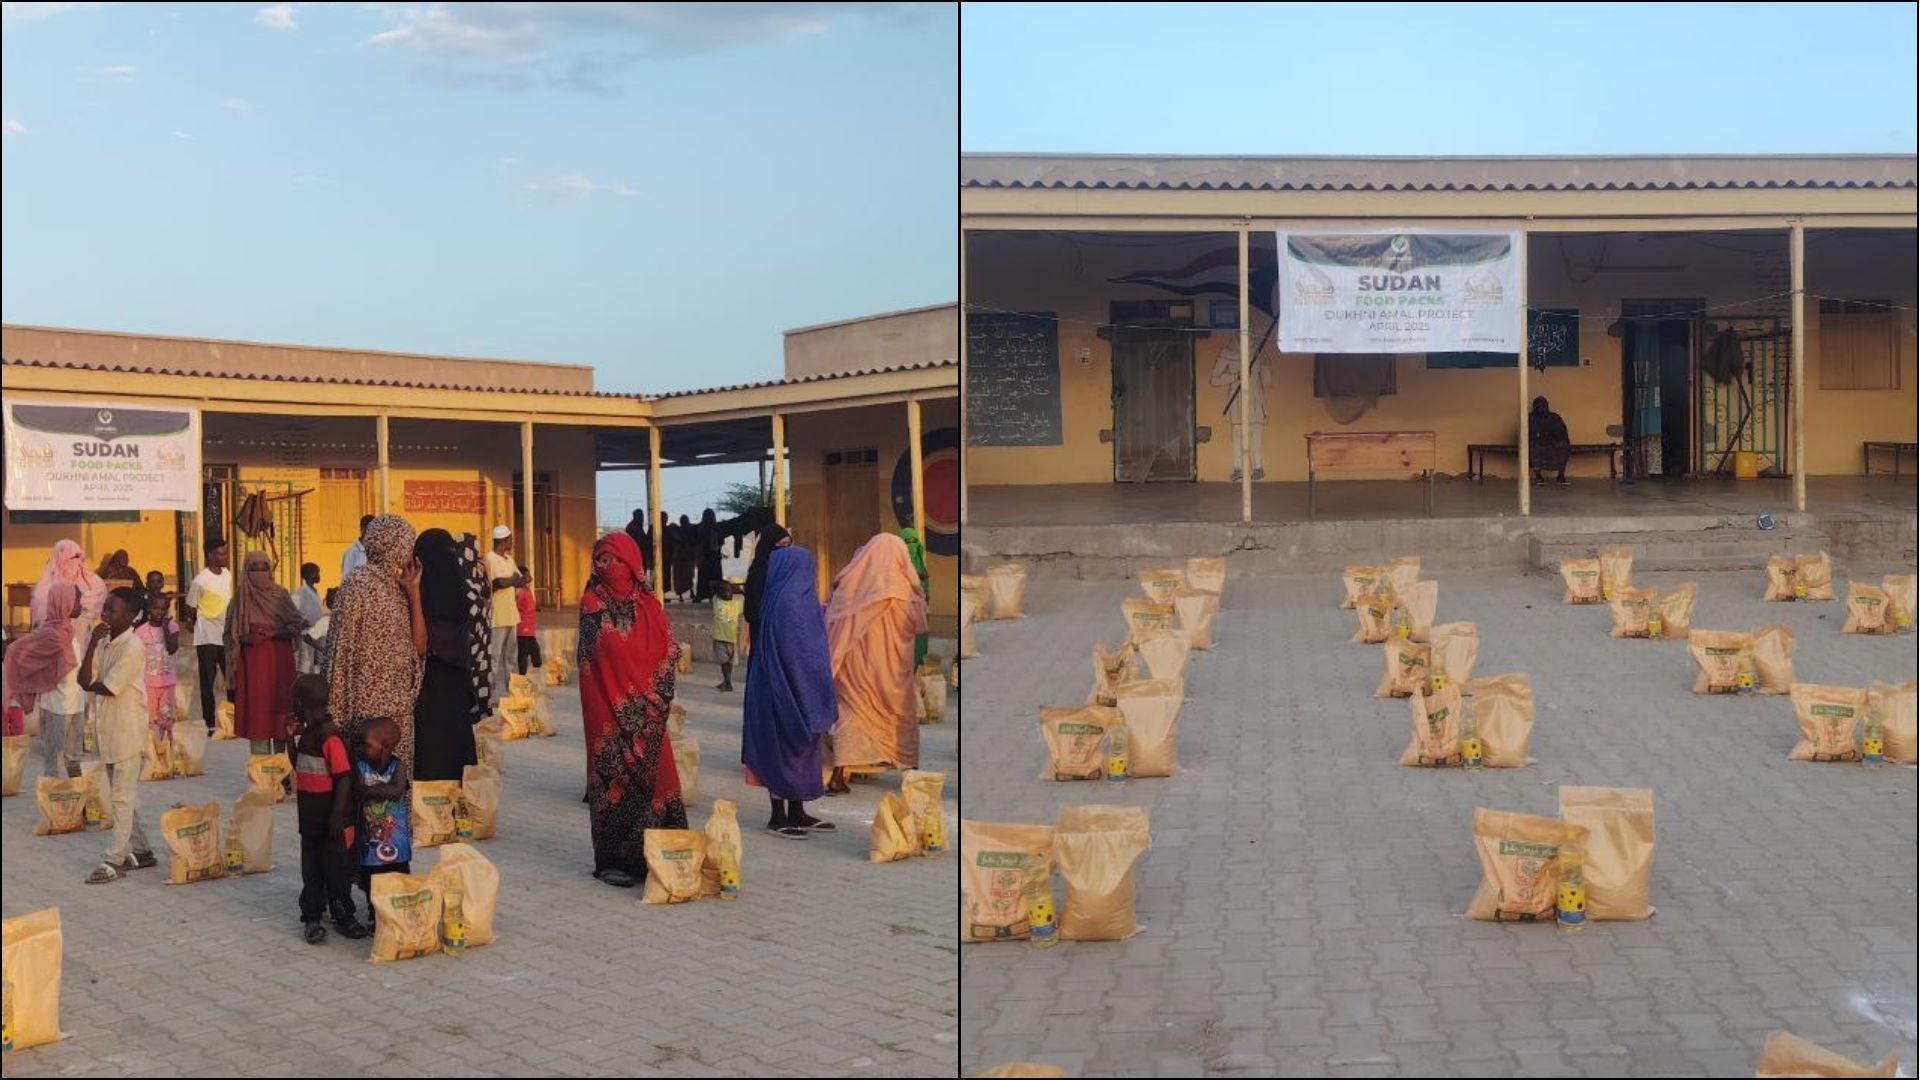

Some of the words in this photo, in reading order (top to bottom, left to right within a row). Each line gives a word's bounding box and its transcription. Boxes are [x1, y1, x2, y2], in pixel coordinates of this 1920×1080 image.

[1358, 275, 1441, 291] SUDAN
[1355, 296, 1394, 306] FOOD
[1399, 296, 1445, 306] PACKS
[1325, 310, 1376, 320] DUKHNI
[1379, 310, 1415, 320] AMAL
[1418, 310, 1475, 320] PROJECT
[1368, 322, 1402, 331] APRIL
[1405, 322, 1430, 331] 2025
[73, 442, 139, 458] SUDAN
[71, 460, 103, 470] FOOD
[107, 461, 143, 470] PACKS
[48, 472, 90, 481] DUKHNI
[91, 473, 121, 482] AMAL
[123, 474, 165, 482] PROJECT
